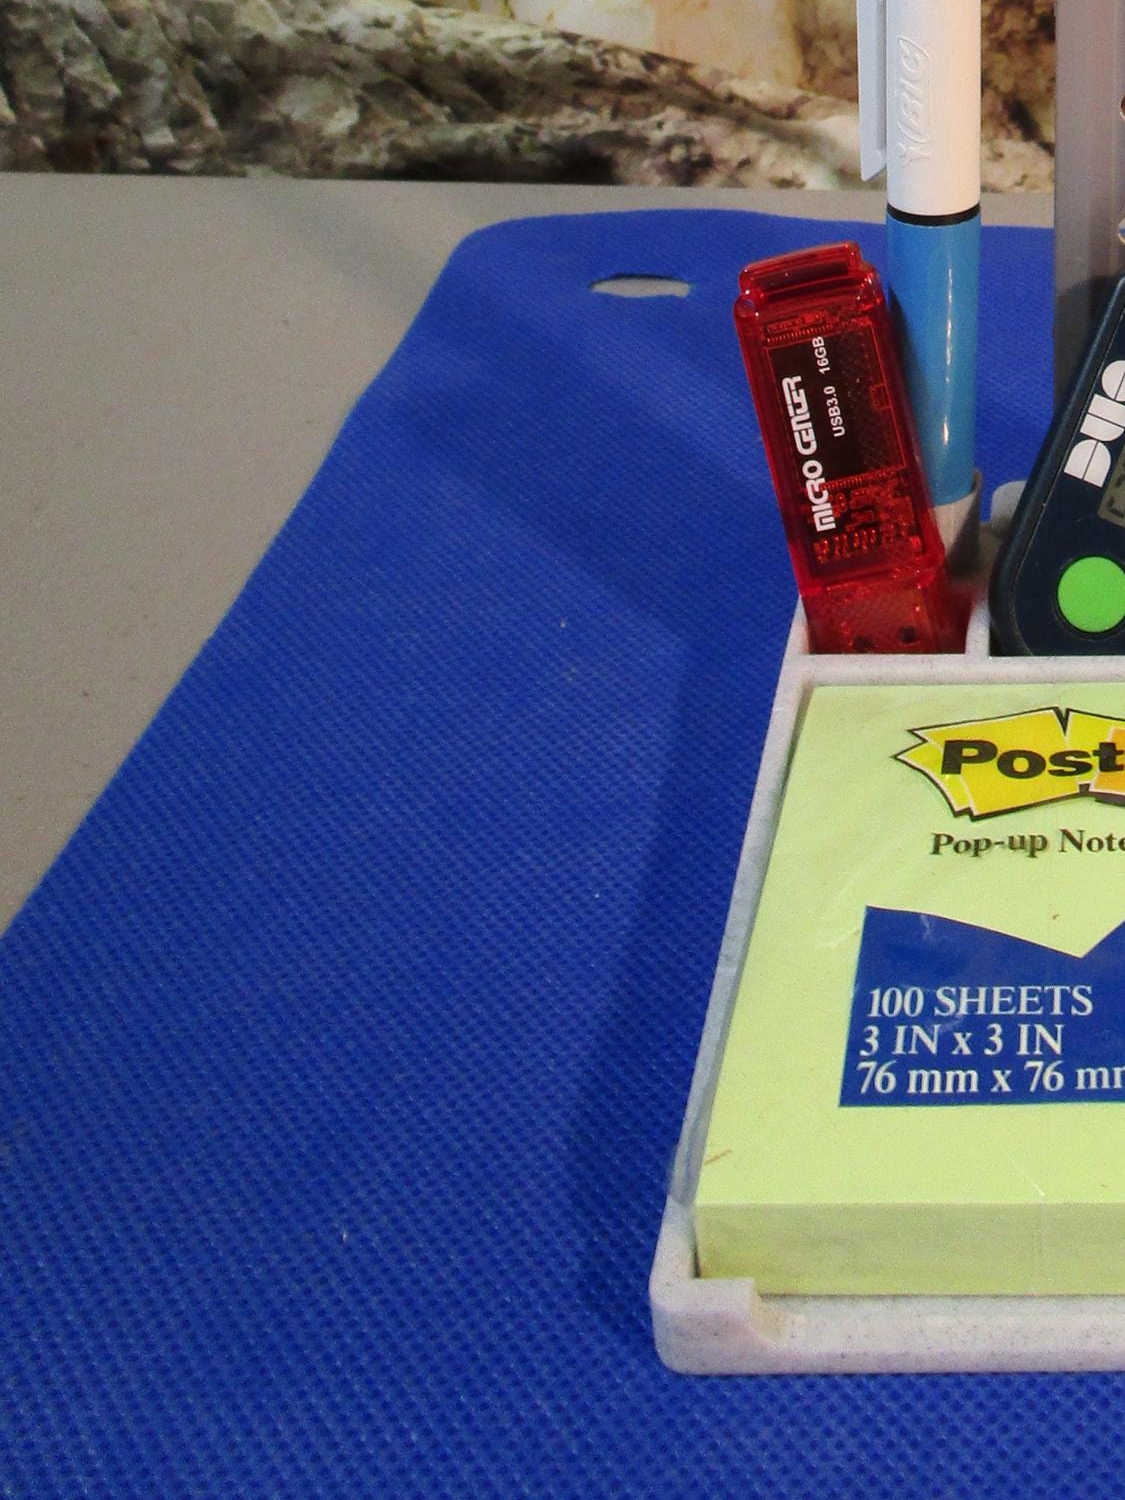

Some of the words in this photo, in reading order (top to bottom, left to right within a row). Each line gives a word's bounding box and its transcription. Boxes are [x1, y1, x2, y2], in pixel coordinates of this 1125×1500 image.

[812, 336, 830, 375] 16GB
[782, 376, 817, 455] CENTER
[823, 385, 845, 437] USB3.0
[802, 460, 836, 532] MICRO
[930, 832, 1048, 858] Pop-up
[867, 986, 925, 1018] 100
[933, 985, 1094, 1017] SHEETS
[859, 1025, 880, 1058] 3
[893, 1025, 940, 1056] IN
[951, 1031, 973, 1056] x
[983, 1024, 1004, 1056] 3
[1016, 1024, 1065, 1055] IN
[856, 1061, 898, 1095] 76
[907, 1066, 980, 1094] mm
[990, 1069, 1013, 1093] x
[1023, 1060, 1065, 1093] 76
